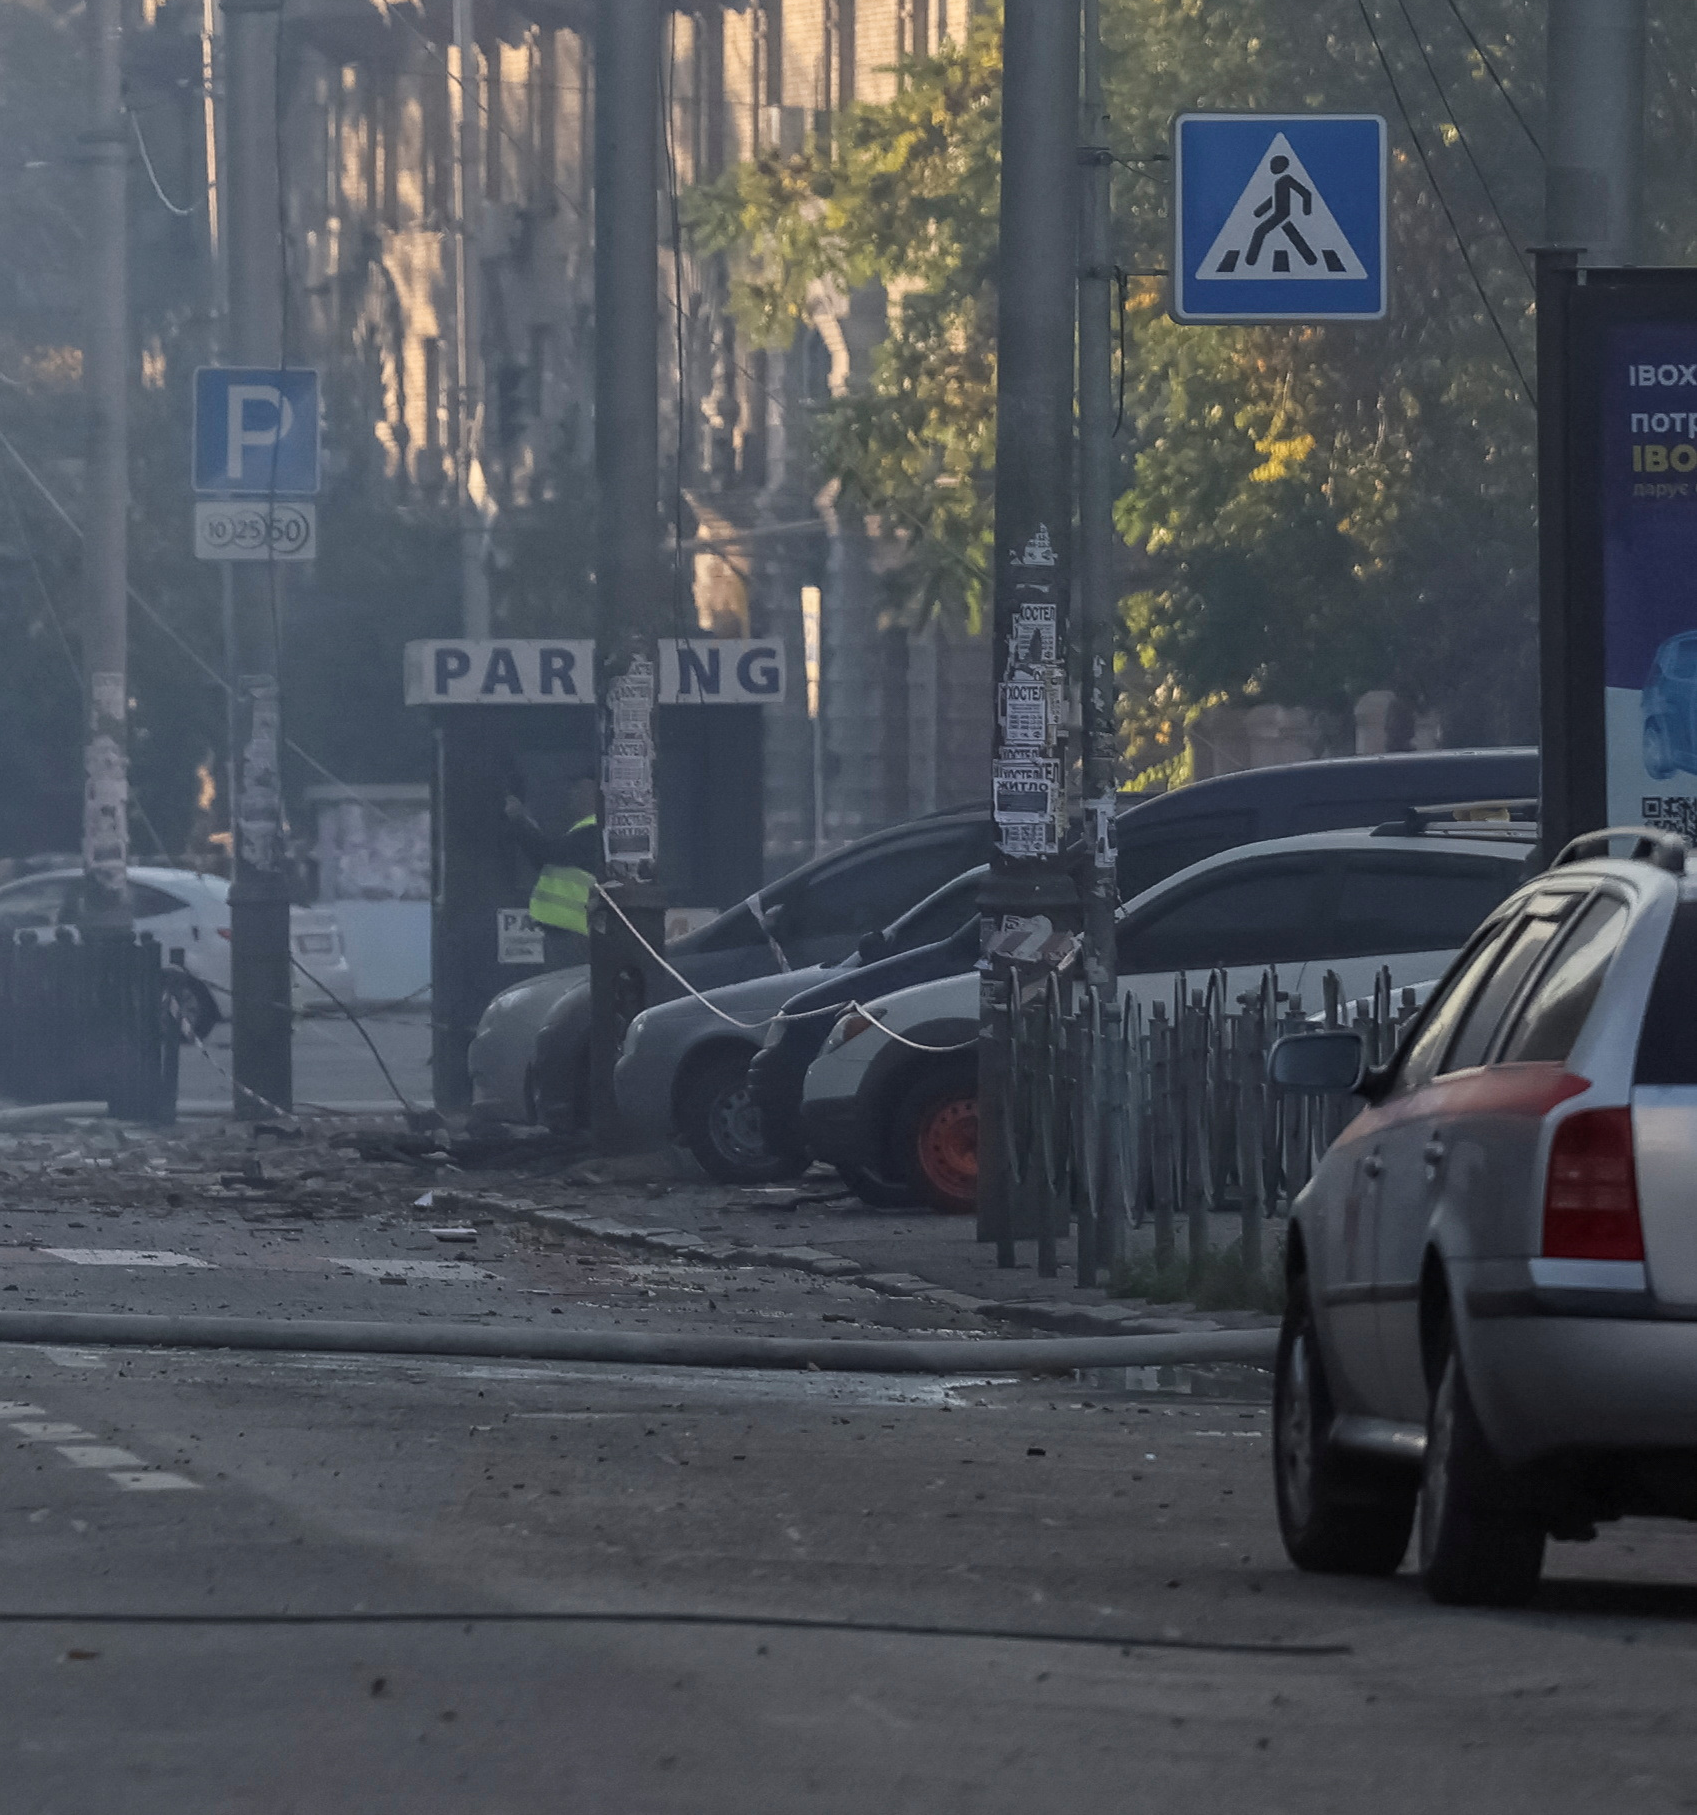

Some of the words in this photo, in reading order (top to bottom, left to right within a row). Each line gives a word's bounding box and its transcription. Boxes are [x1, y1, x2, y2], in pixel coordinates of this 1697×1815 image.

[1629, 364, 1697, 386] IBOX
[228, 385, 295, 479] P
[208, 520, 226, 539] 10
[236, 519, 261, 539] 25
[434, 647, 780, 696] PARNG
[1007, 686, 1045, 701] ХОСТЕЛ
[997, 781, 1049, 792] ЖИТЛО
